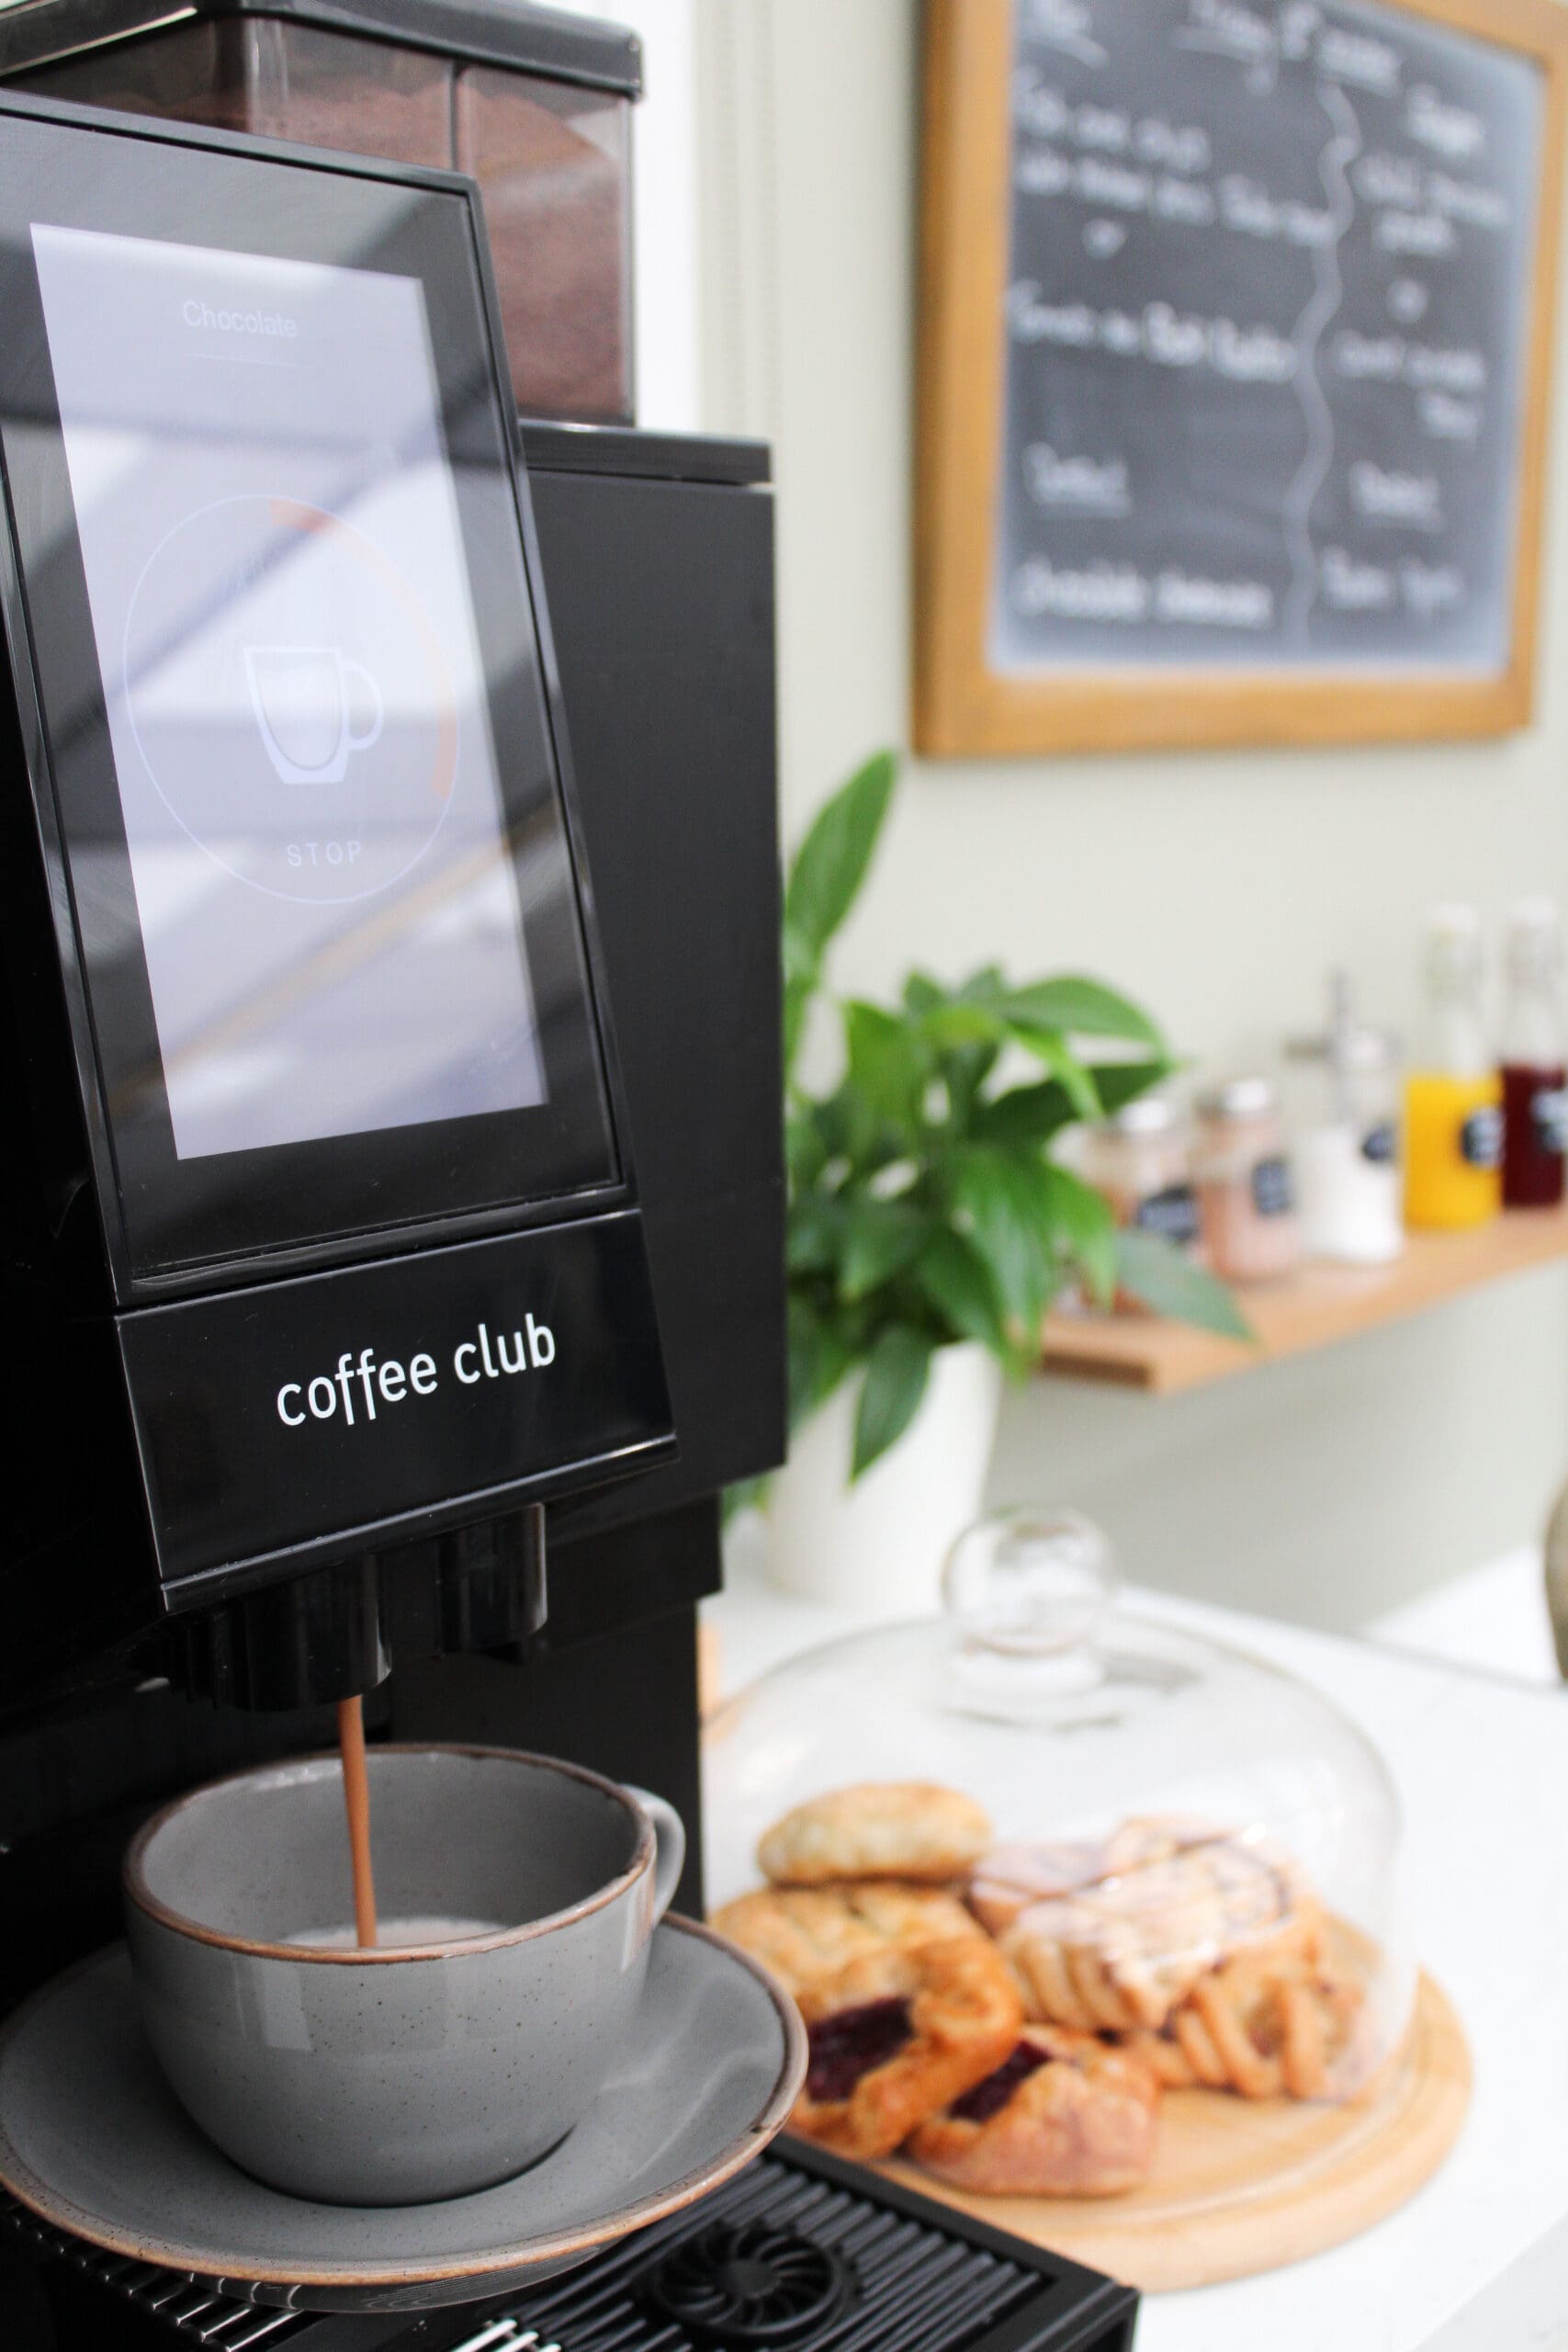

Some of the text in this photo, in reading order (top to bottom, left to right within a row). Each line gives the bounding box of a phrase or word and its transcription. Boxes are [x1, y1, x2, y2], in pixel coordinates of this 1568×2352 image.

[183, 300, 299, 338] Chocolate
[287, 840, 362, 867] STOP
[277, 1313, 556, 1425] coffee club
